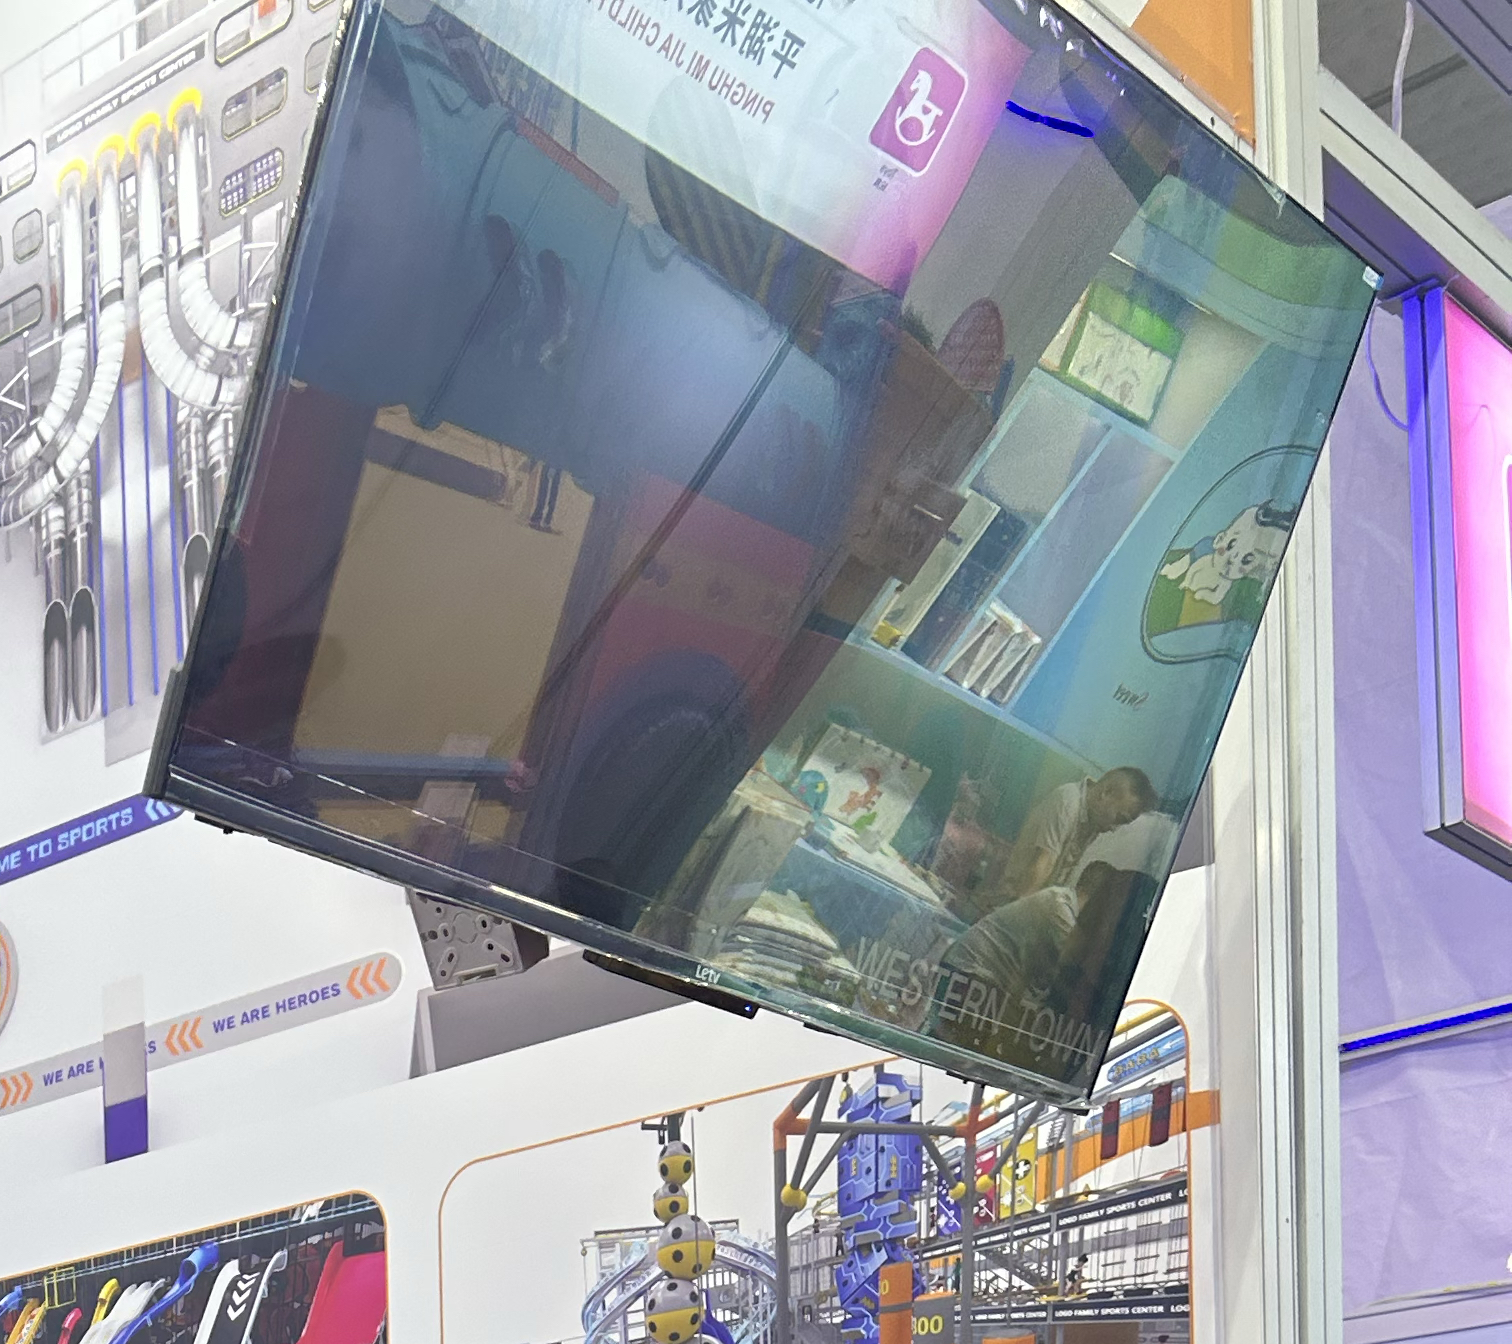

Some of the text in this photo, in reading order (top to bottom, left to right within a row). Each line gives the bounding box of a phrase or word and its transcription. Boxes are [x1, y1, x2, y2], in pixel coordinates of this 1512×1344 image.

[26, 838, 53, 863] TO
[57, 806, 134, 852] SPORTS
[212, 982, 342, 1035] WE ARE HEROES
[66, 1059, 96, 1080] ARE
[1105, 1201, 1137, 1216] SPORTS
[1137, 1192, 1173, 1208] CENTER
[1100, 1306, 1130, 1316] SPORTS
[1131, 1304, 1165, 1315] CENTER
